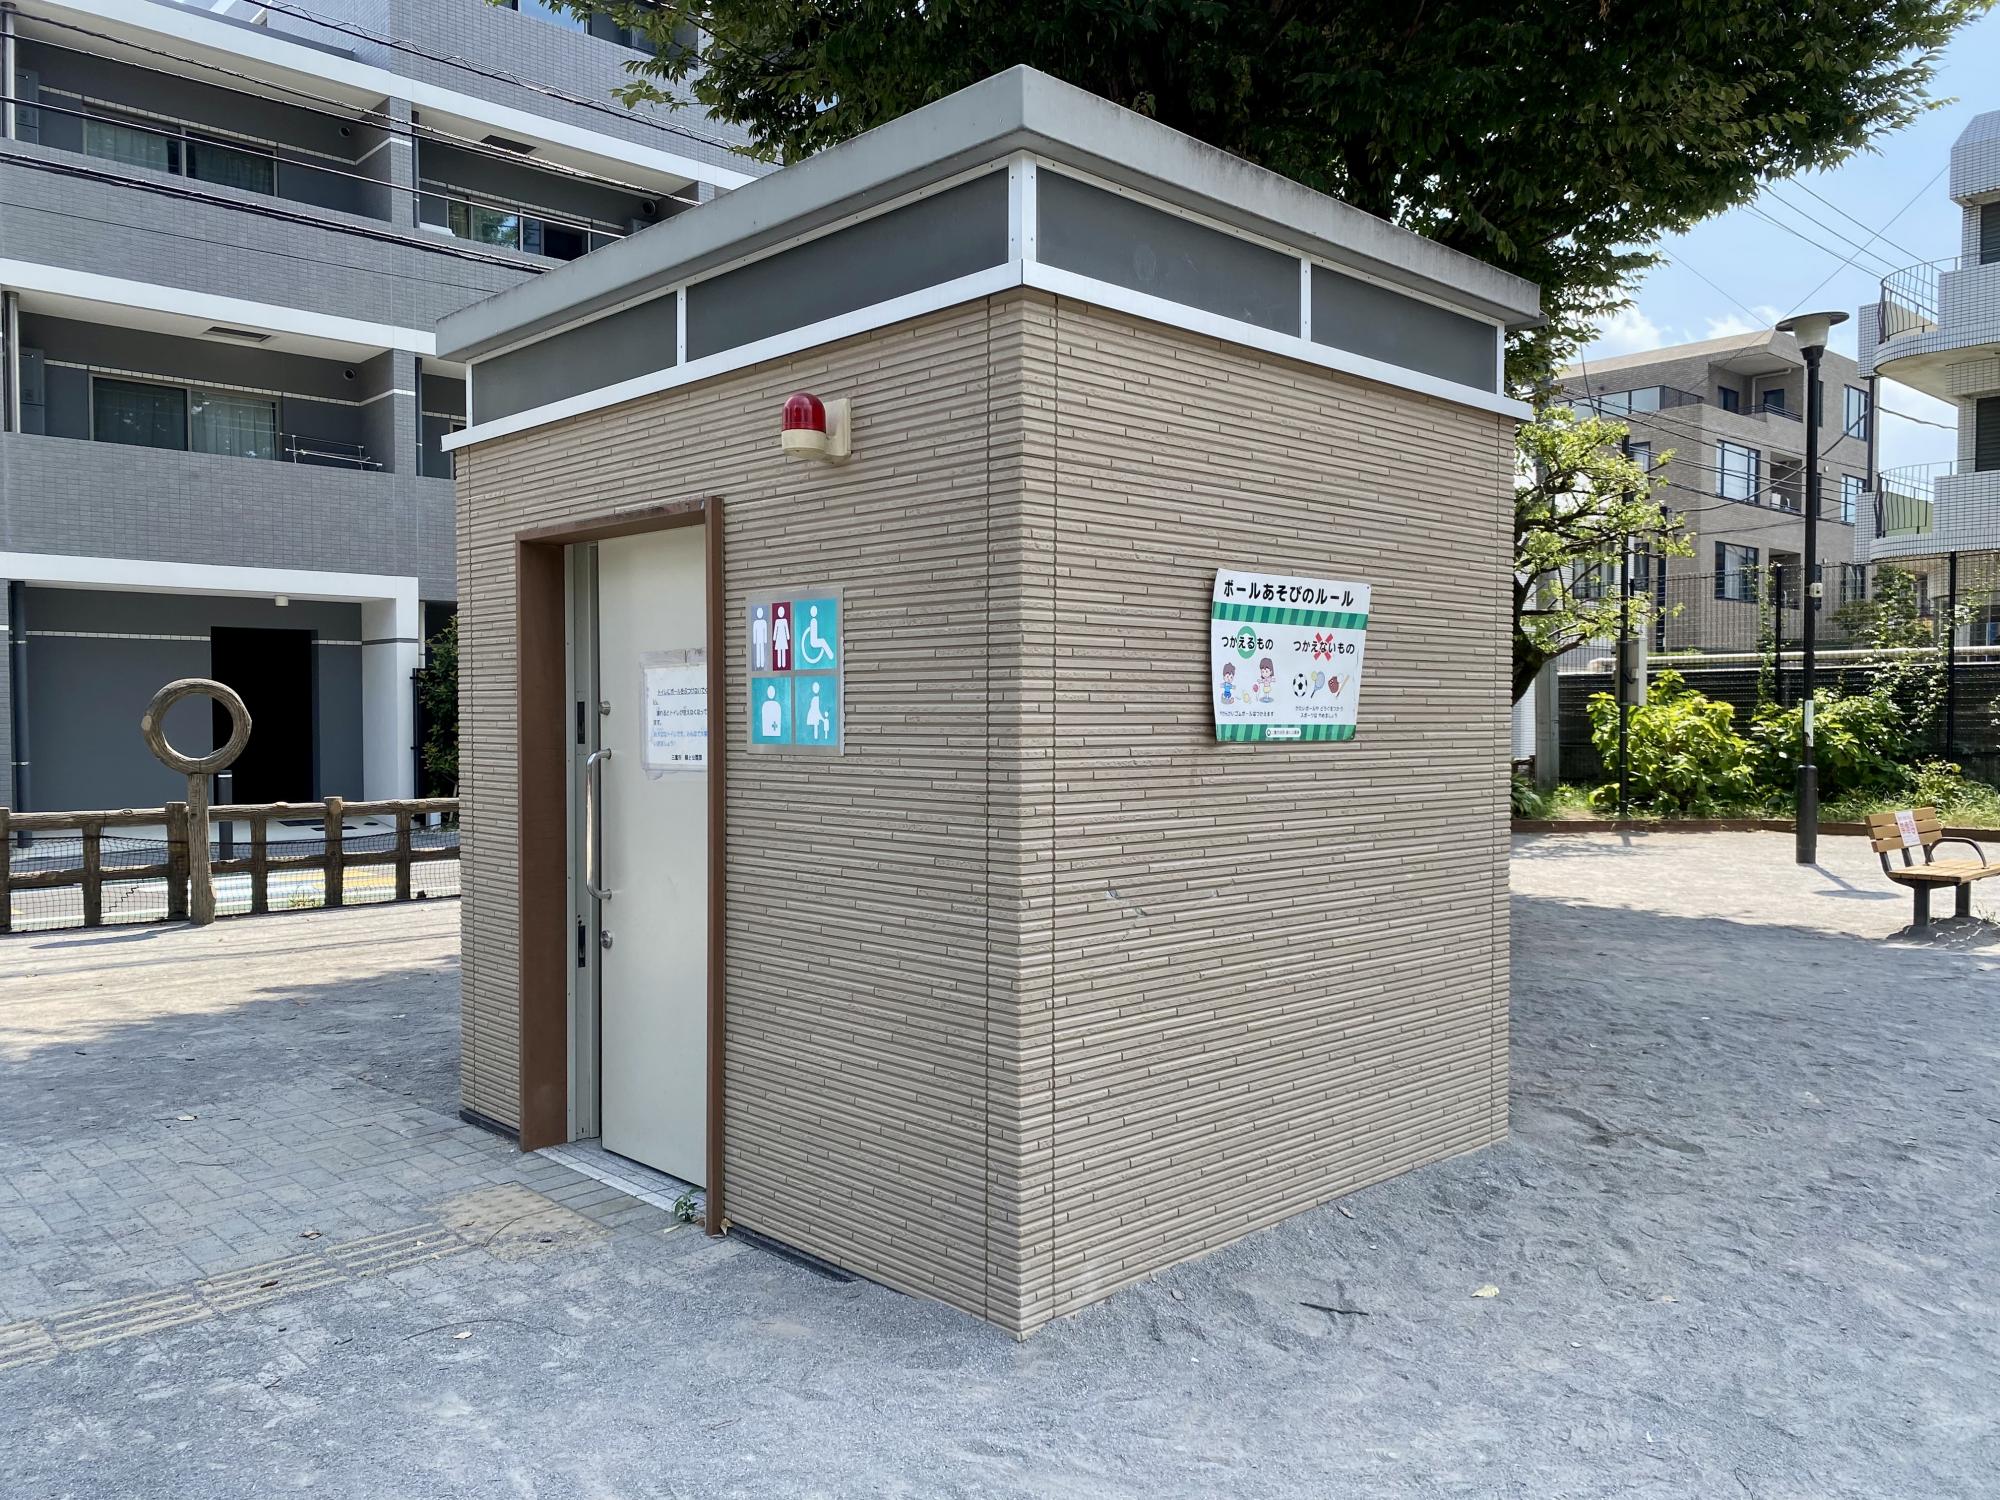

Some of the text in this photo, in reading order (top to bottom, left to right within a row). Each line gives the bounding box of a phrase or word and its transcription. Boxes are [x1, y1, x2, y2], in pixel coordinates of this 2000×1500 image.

[1223, 579, 1354, 607] ボールあそびのルール
[1221, 635, 1274, 650] つかえるもの
[1293, 640, 1356, 655] つかえないもの
